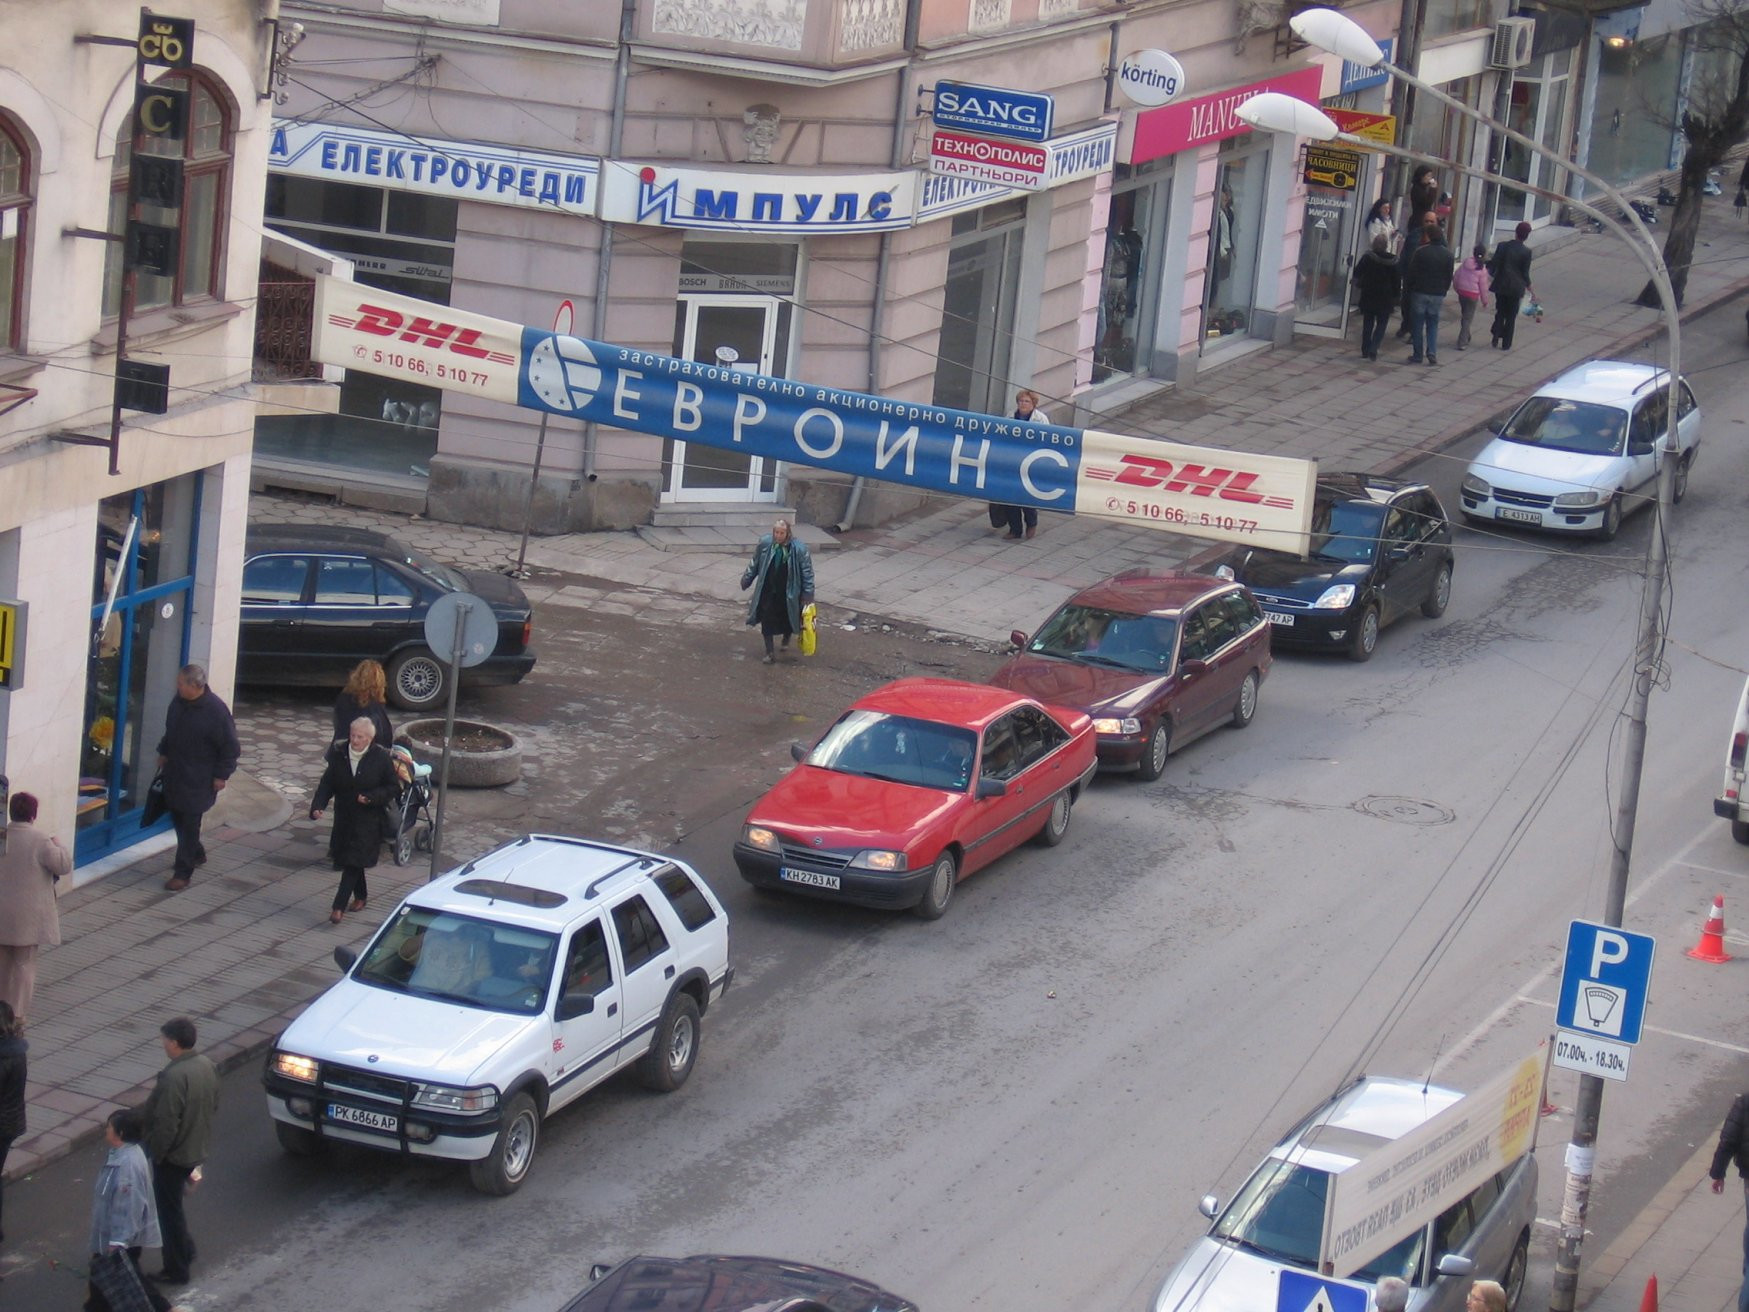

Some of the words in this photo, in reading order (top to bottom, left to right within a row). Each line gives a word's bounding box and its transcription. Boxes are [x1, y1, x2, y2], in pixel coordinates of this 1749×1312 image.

[1121, 61, 1177, 96] körting
[938, 92, 1037, 125] SANG
[935, 137, 1044, 167] ТЕХНОПОЛИС
[321, 141, 586, 205] ЕЛЕКТРОУРЕДИ
[934, 160, 1038, 186] ПАРТНЬОРИ
[637, 166, 899, 224] ИМПУЛС
[680, 278, 707, 287] BOSCH
[353, 303, 490, 359] DHL
[373, 350, 383, 363] 5
[387, 353, 404, 368] 10
[436, 364, 446, 378] 5
[451, 367, 467, 383] 10
[470, 372, 489, 387] 77
[619, 350, 805, 398] застрахователно
[816, 389, 946, 425] акционерно
[954, 417, 1075, 447] дружество
[613, 368, 1070, 501] ЕВРОИНС
[1114, 454, 1265, 504] DHL
[1126, 501, 1136, 514] 5
[1142, 504, 1160, 518] 10
[1199, 513, 1210, 526] 5
[1216, 516, 1234, 531] 10
[1239, 519, 1258, 534] 77
[1590, 930, 1629, 979] P
[1557, 1041, 1587, 1063] 07.00ч.
[1595, 1051, 1625, 1072] 18.30ч.
[351, 1110, 378, 1126] 6866
[380, 1116, 396, 1129] AP
